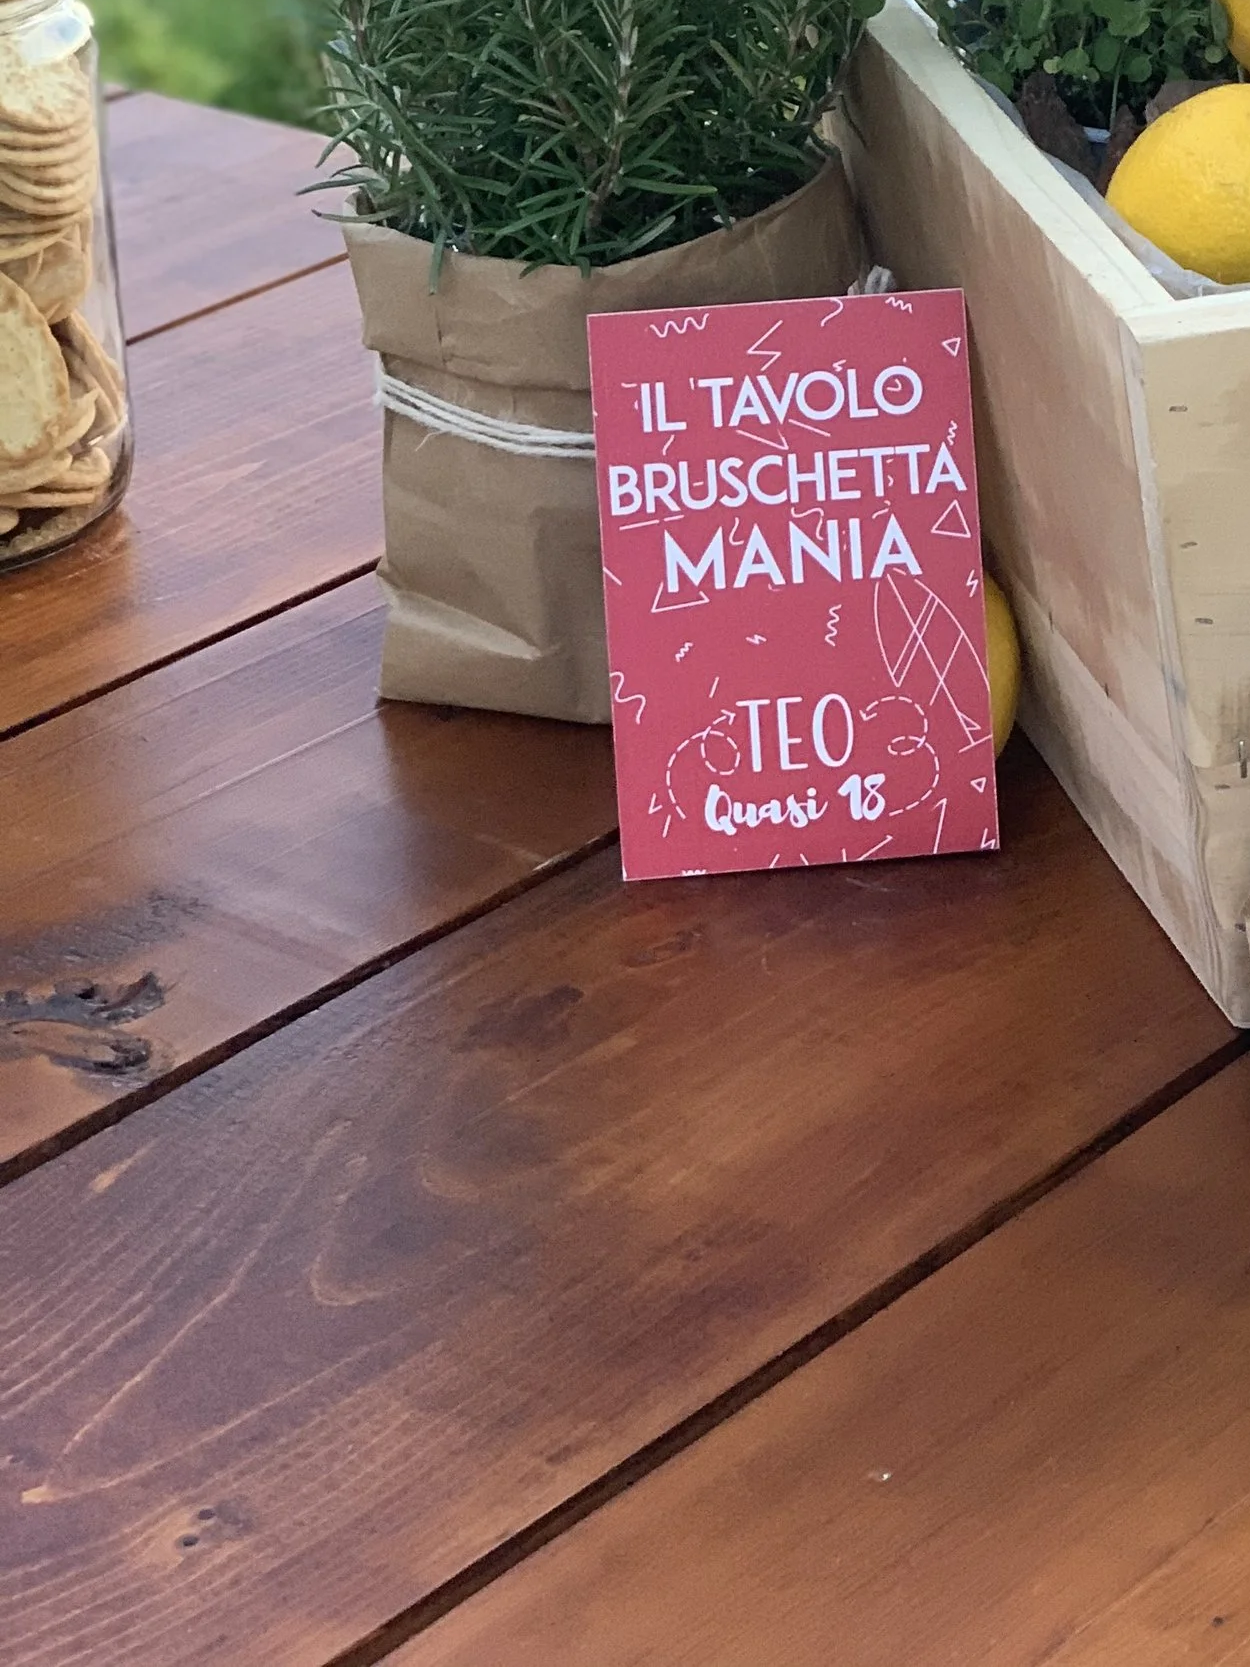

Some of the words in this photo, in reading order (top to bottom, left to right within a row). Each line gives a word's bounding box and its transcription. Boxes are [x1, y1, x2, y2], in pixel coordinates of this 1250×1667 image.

[639, 381, 687, 433] IL
[697, 365, 923, 428] TAVOLO
[609, 442, 966, 516] BRUSCHETTA
[664, 514, 922, 593] MANIA
[736, 692, 854, 773] TEO
[704, 784, 829, 836] Quasi
[838, 773, 886, 823] 18
